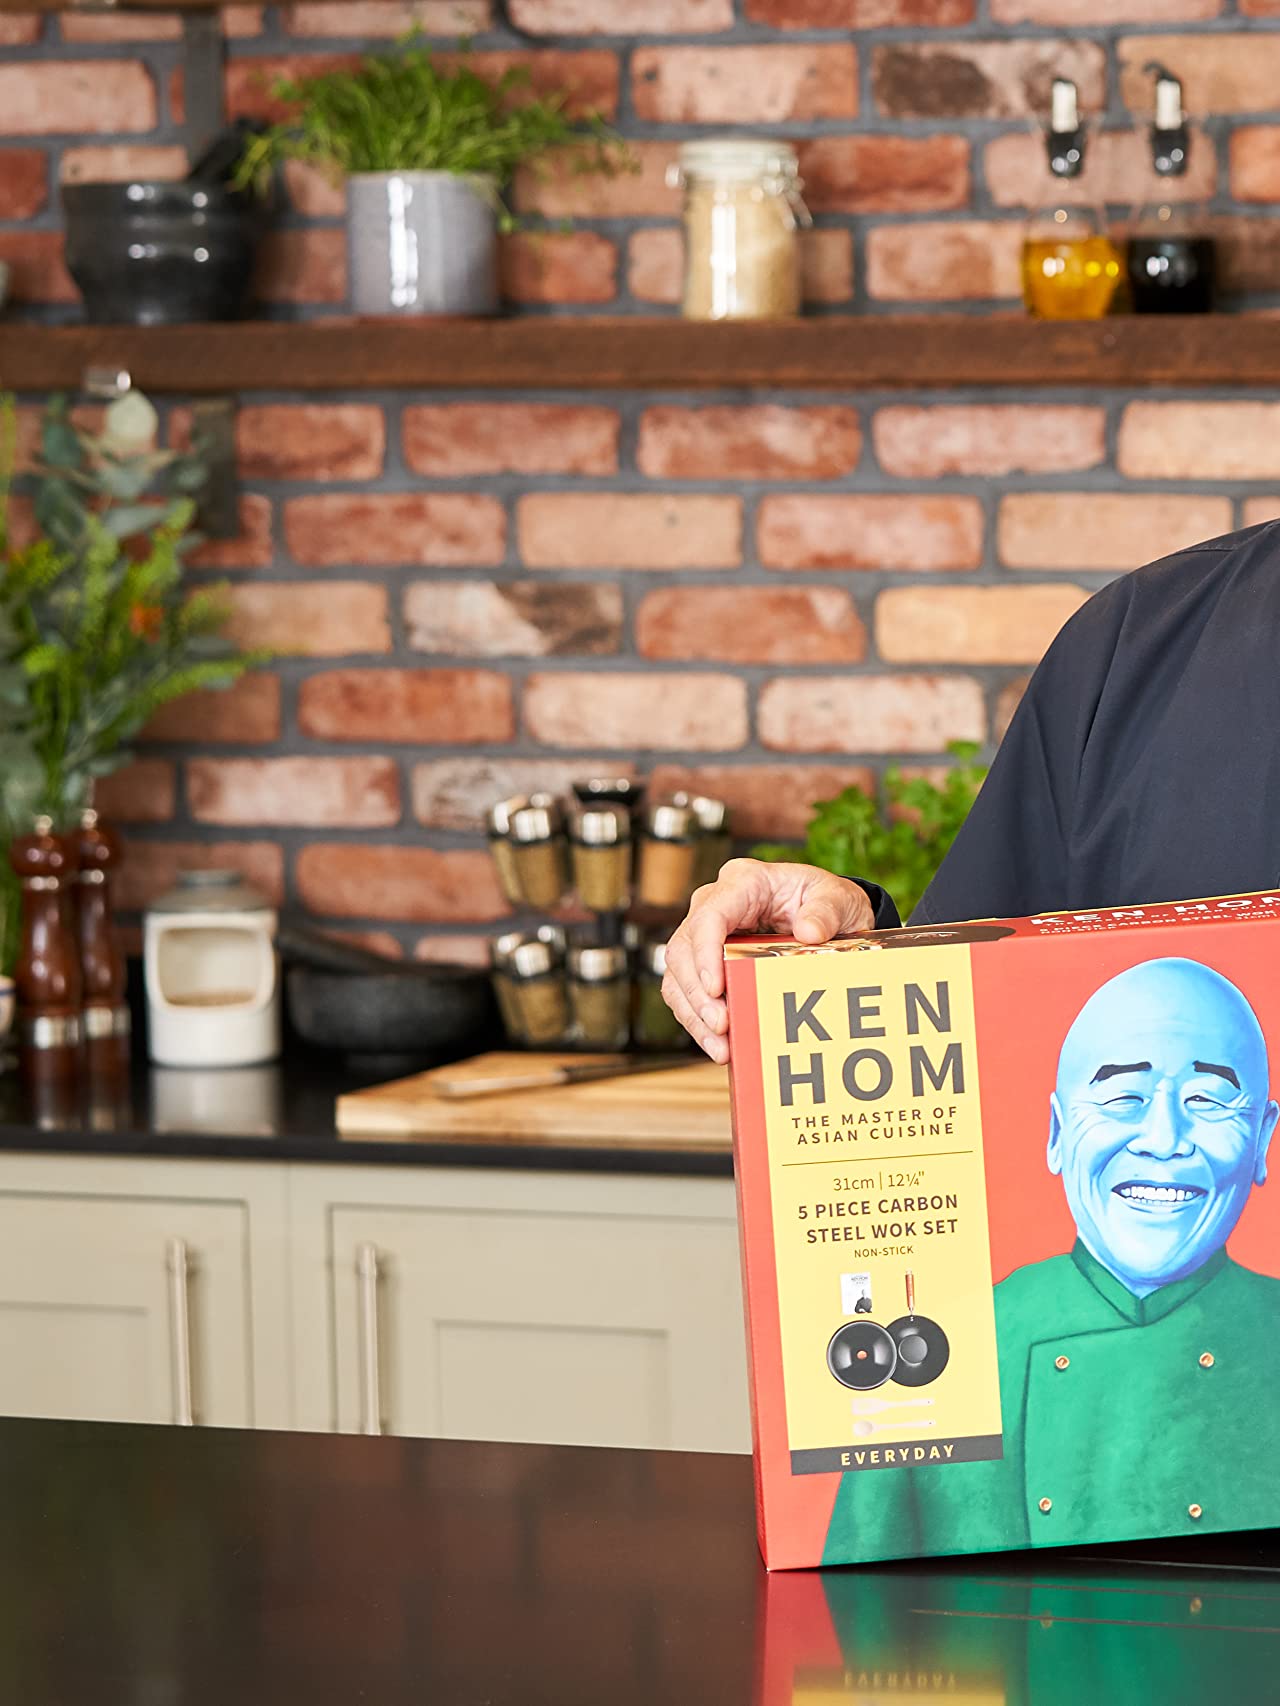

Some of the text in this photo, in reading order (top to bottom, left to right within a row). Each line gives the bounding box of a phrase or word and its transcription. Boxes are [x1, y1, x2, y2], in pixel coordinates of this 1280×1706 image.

[1031, 910, 1145, 924] KEN
[1236, 909, 1275, 917] WOK
[783, 981, 951, 1043] KEN
[777, 1042, 965, 1106] HOM
[792, 1106, 958, 1129] THE MASTER OF
[797, 1122, 954, 1145] ASIAN CUISINE
[833, 1177, 875, 1191] 31cm
[798, 1194, 958, 1220] 5 PIECE CARBON
[807, 1219, 958, 1244] STEEL WOK SET
[854, 1245, 914, 1258] NON-STICK
[841, 1444, 954, 1466] EVERYDAY
